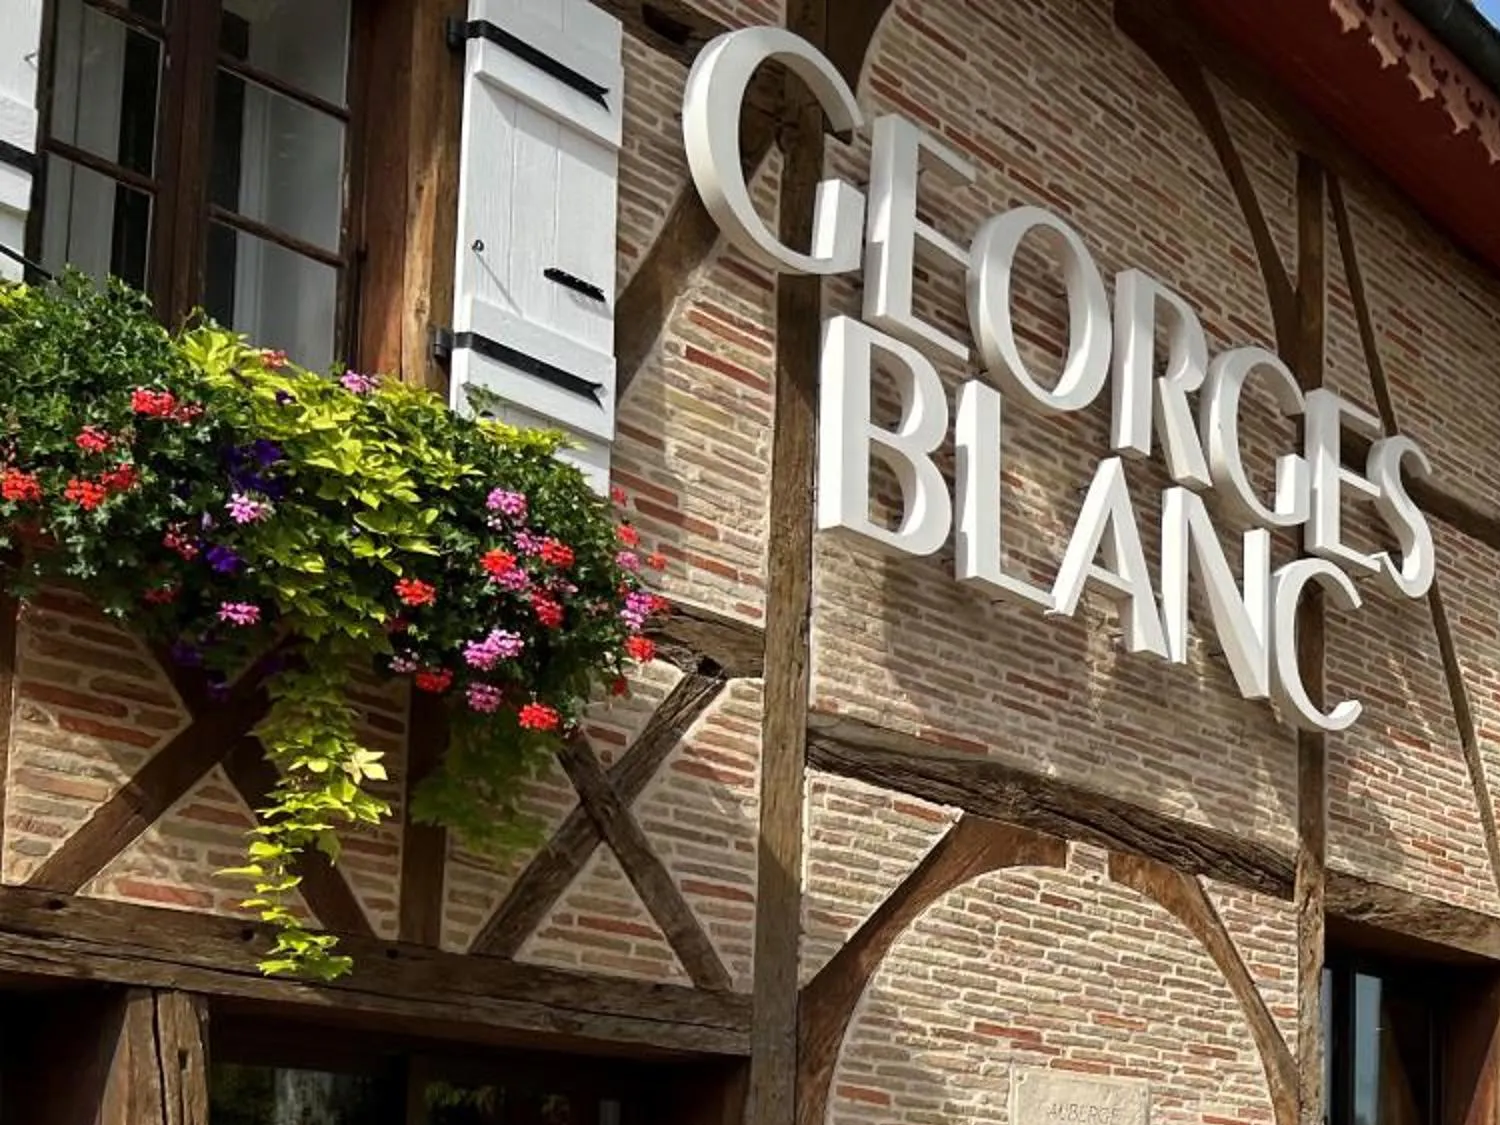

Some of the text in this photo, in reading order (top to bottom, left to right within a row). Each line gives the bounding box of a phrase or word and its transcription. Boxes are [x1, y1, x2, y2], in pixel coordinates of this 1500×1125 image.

[682, 25, 1435, 598] GEORGES
[816, 314, 1363, 731] BLANC
[1046, 1103, 1119, 1125] AUBERGE
